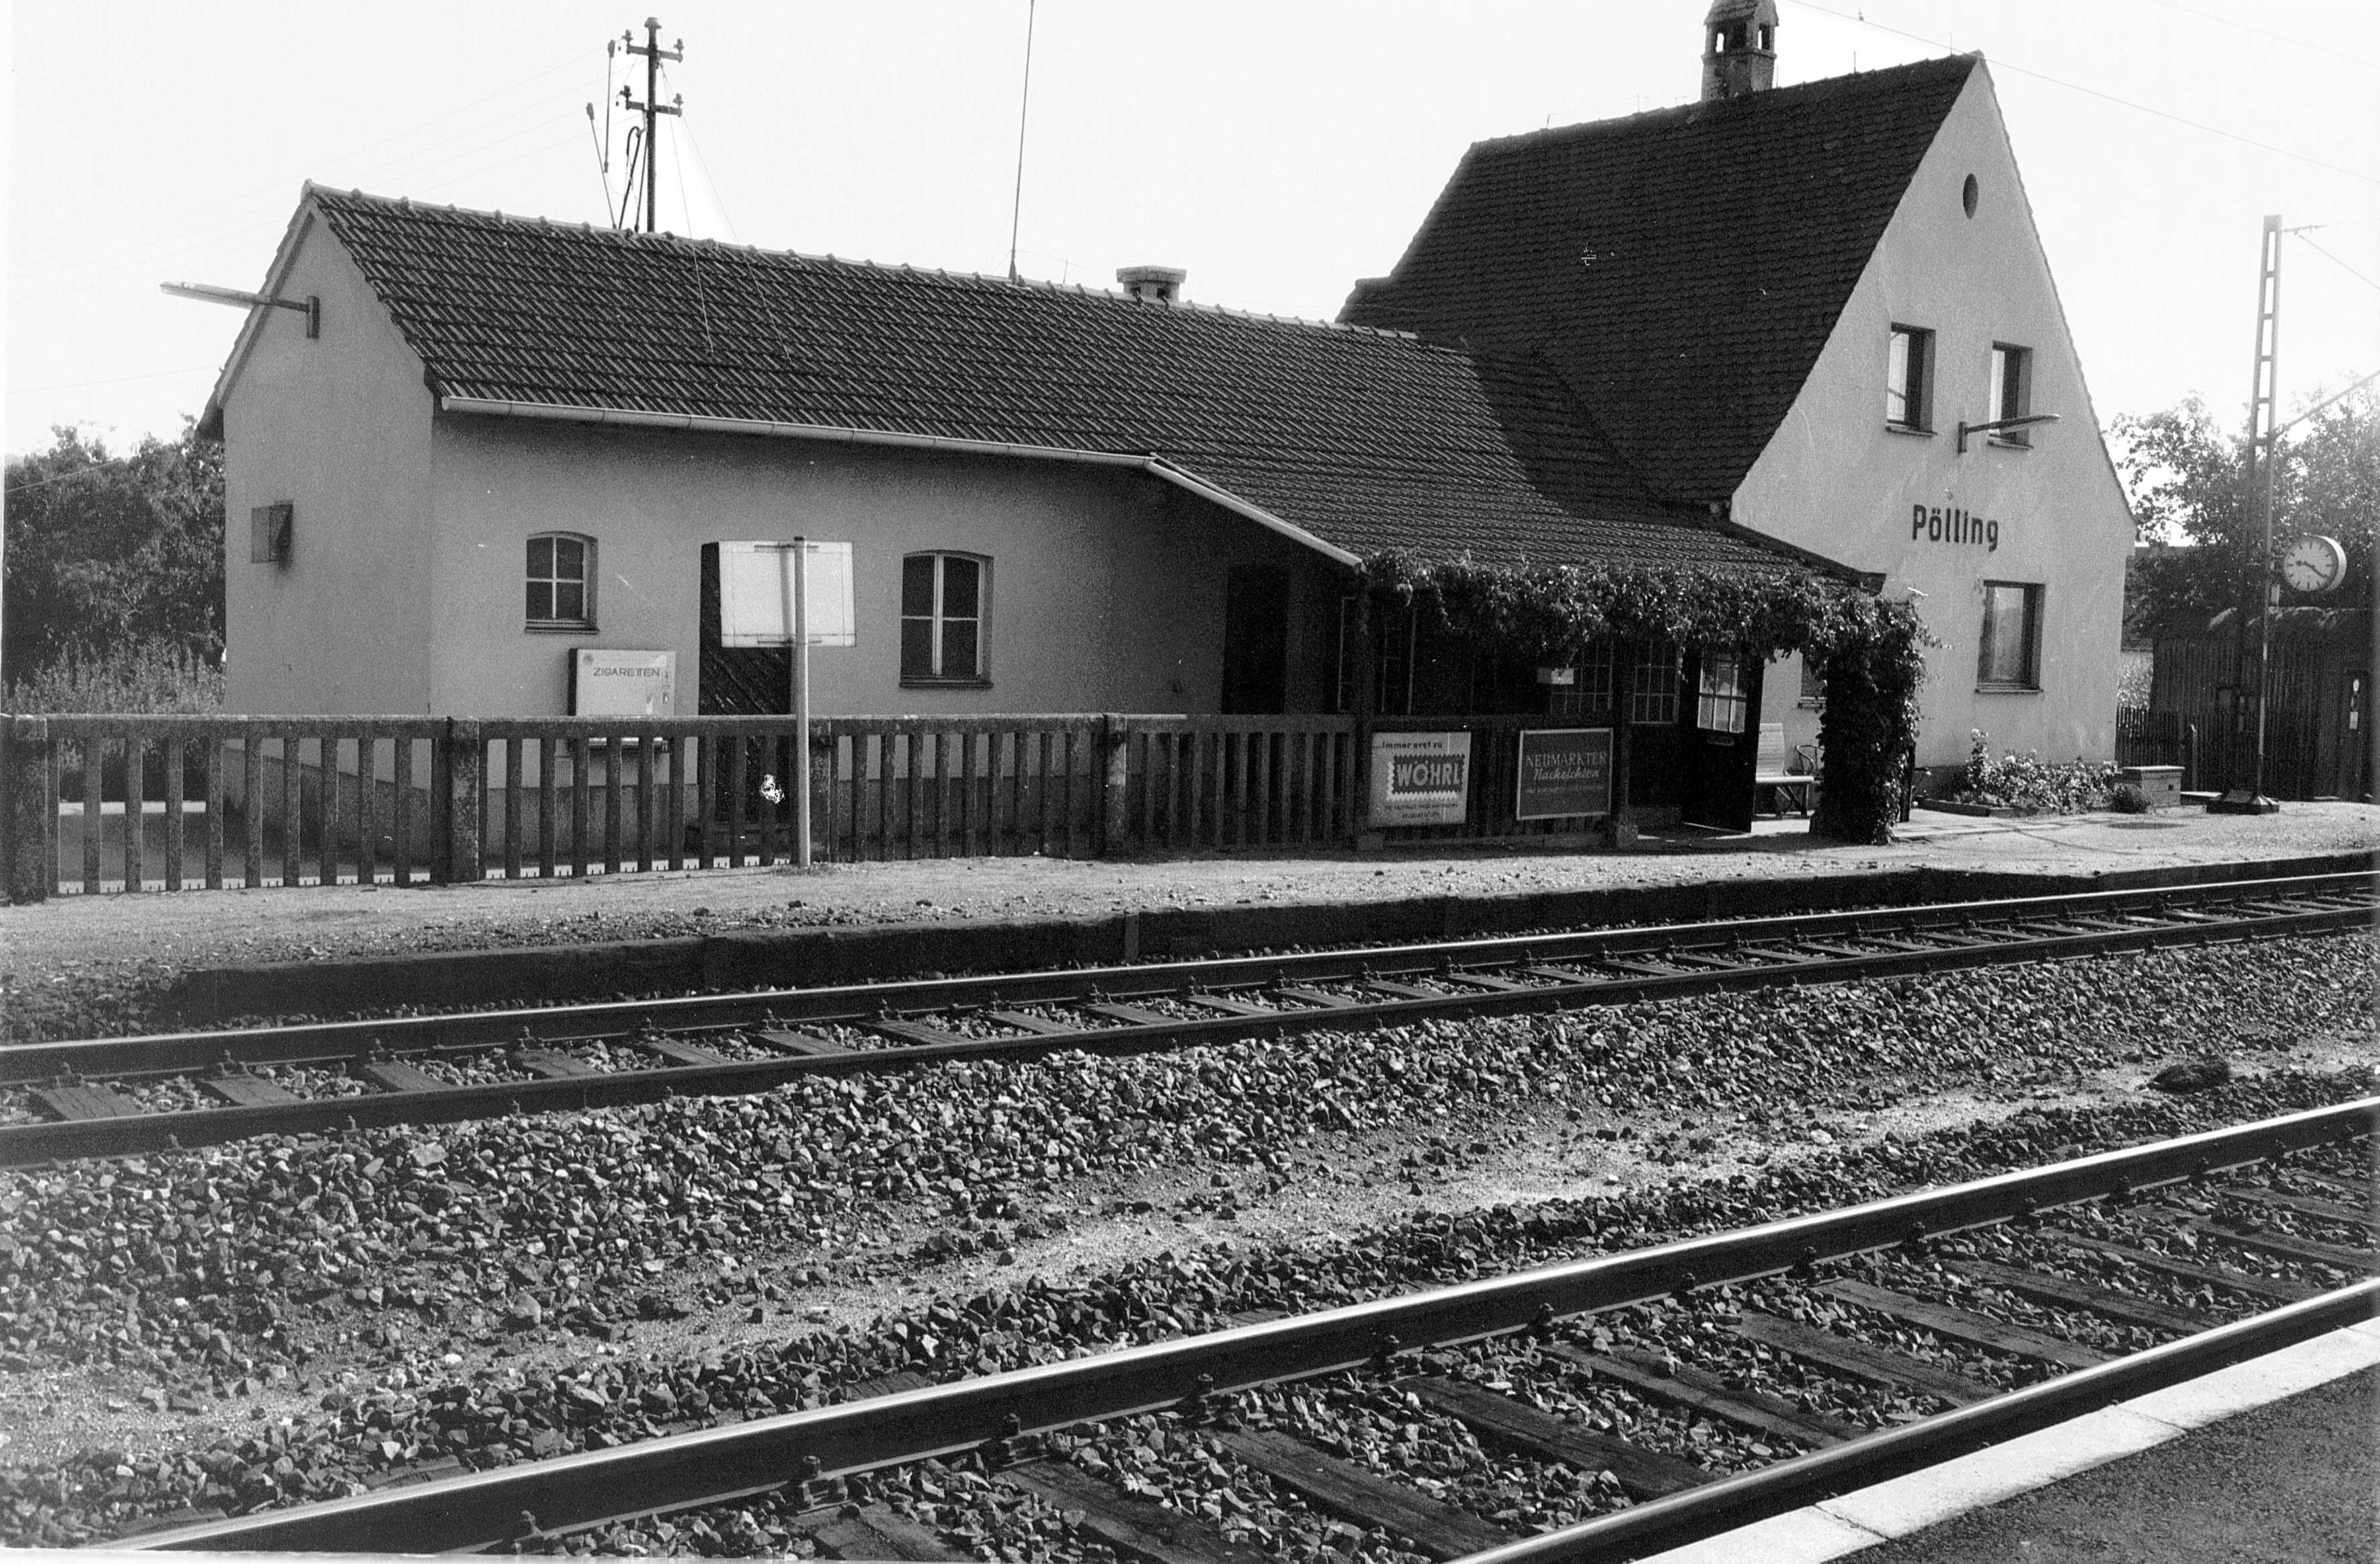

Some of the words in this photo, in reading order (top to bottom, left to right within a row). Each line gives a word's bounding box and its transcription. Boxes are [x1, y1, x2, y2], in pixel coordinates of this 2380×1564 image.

[1912, 504, 1999, 553] Pölling
[593, 667, 660, 677] ZIGARETTEN
[1525, 751, 1607, 768] NEUMARKTER
[1396, 759, 1461, 786] WÖHRL
